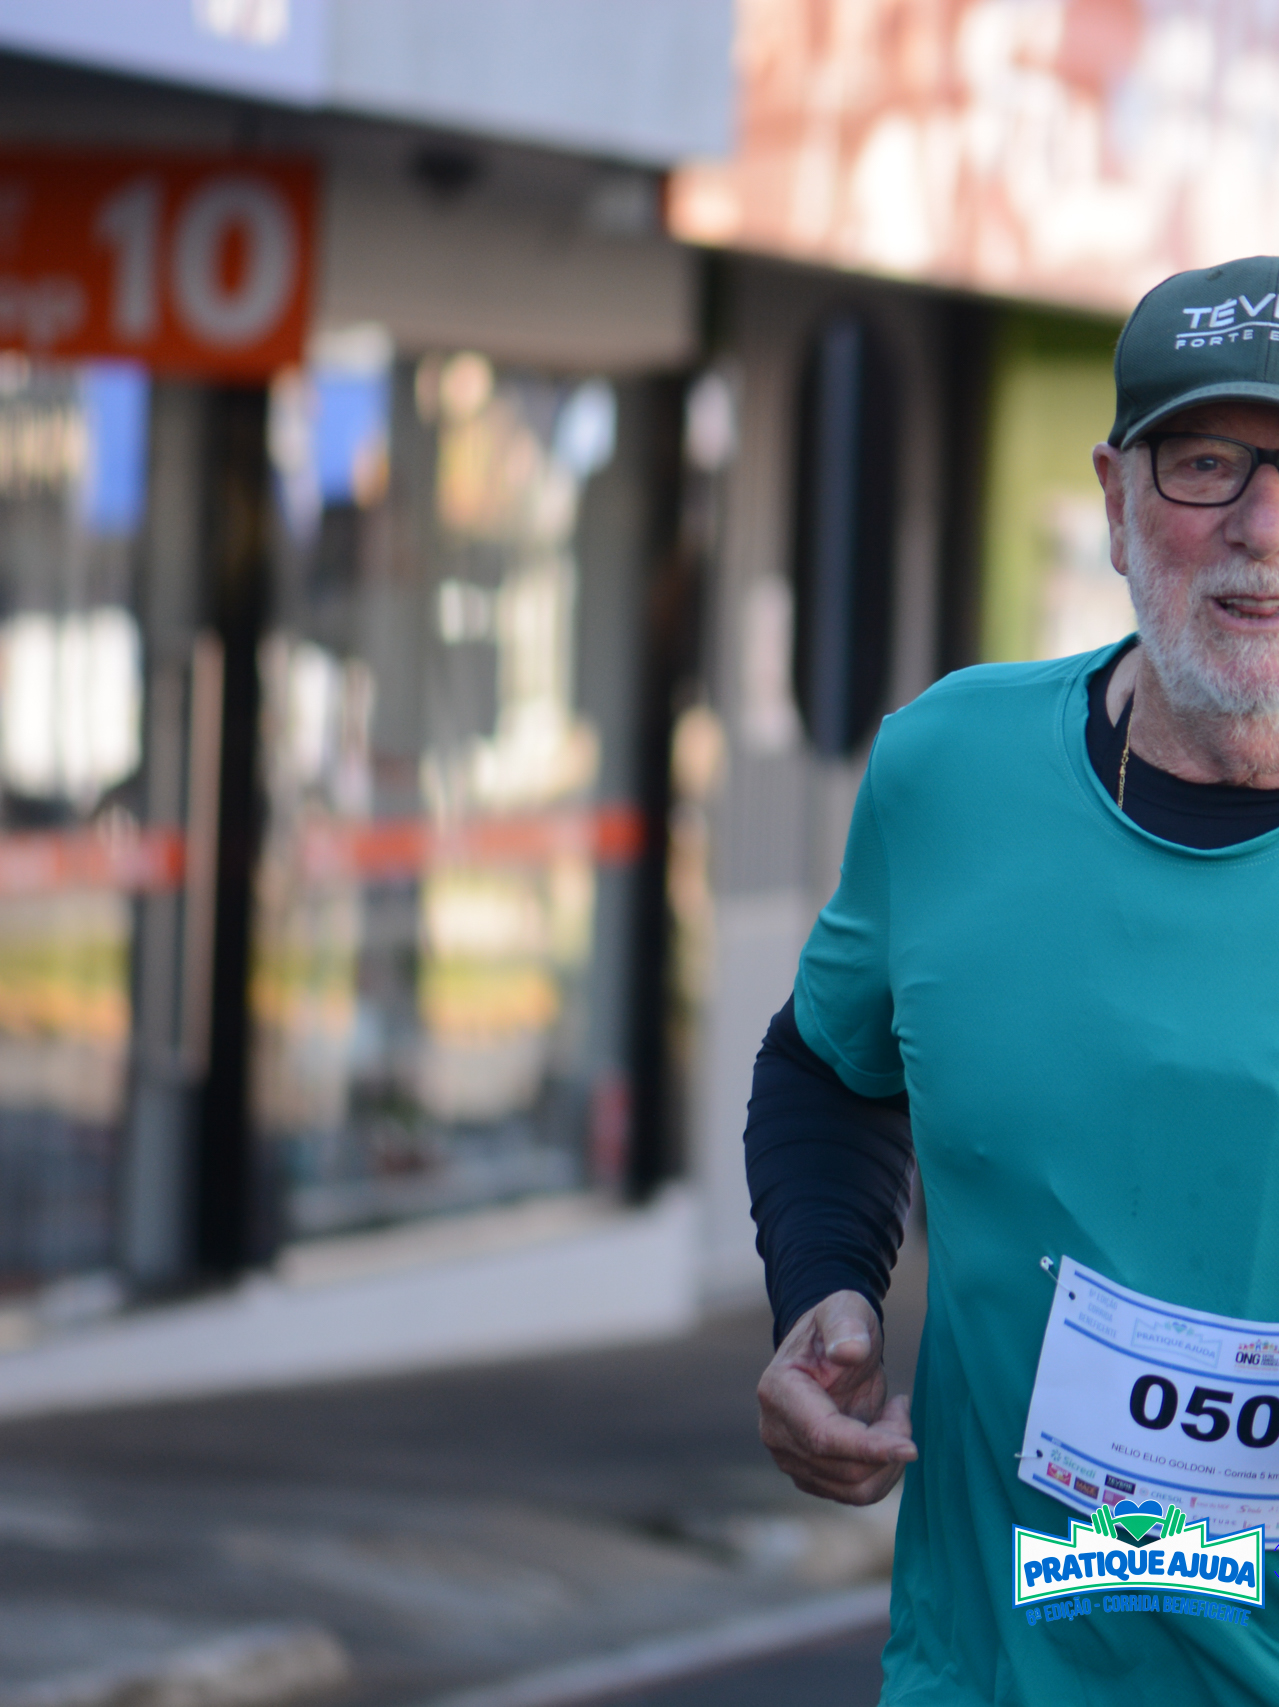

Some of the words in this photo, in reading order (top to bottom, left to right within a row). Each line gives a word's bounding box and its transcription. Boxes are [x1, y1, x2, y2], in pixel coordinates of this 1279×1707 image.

[96, 174, 298, 350] 10
[1175, 329, 1254, 350] FORTE
[1136, 1331, 1184, 1349] PRATIQUE
[1184, 1342, 1216, 1359] AJUDA
[1235, 1351, 1262, 1366] ONG
[1062, 1456, 1097, 1480] Sicredi
[1111, 1442, 1141, 1459] NELIO
[1142, 1452, 1167, 1466] ELIO
[1168, 1459, 1216, 1476] GOLDONI
[1224, 1468, 1258, 1481] Corrida
[1259, 1471, 1266, 1481] 5
